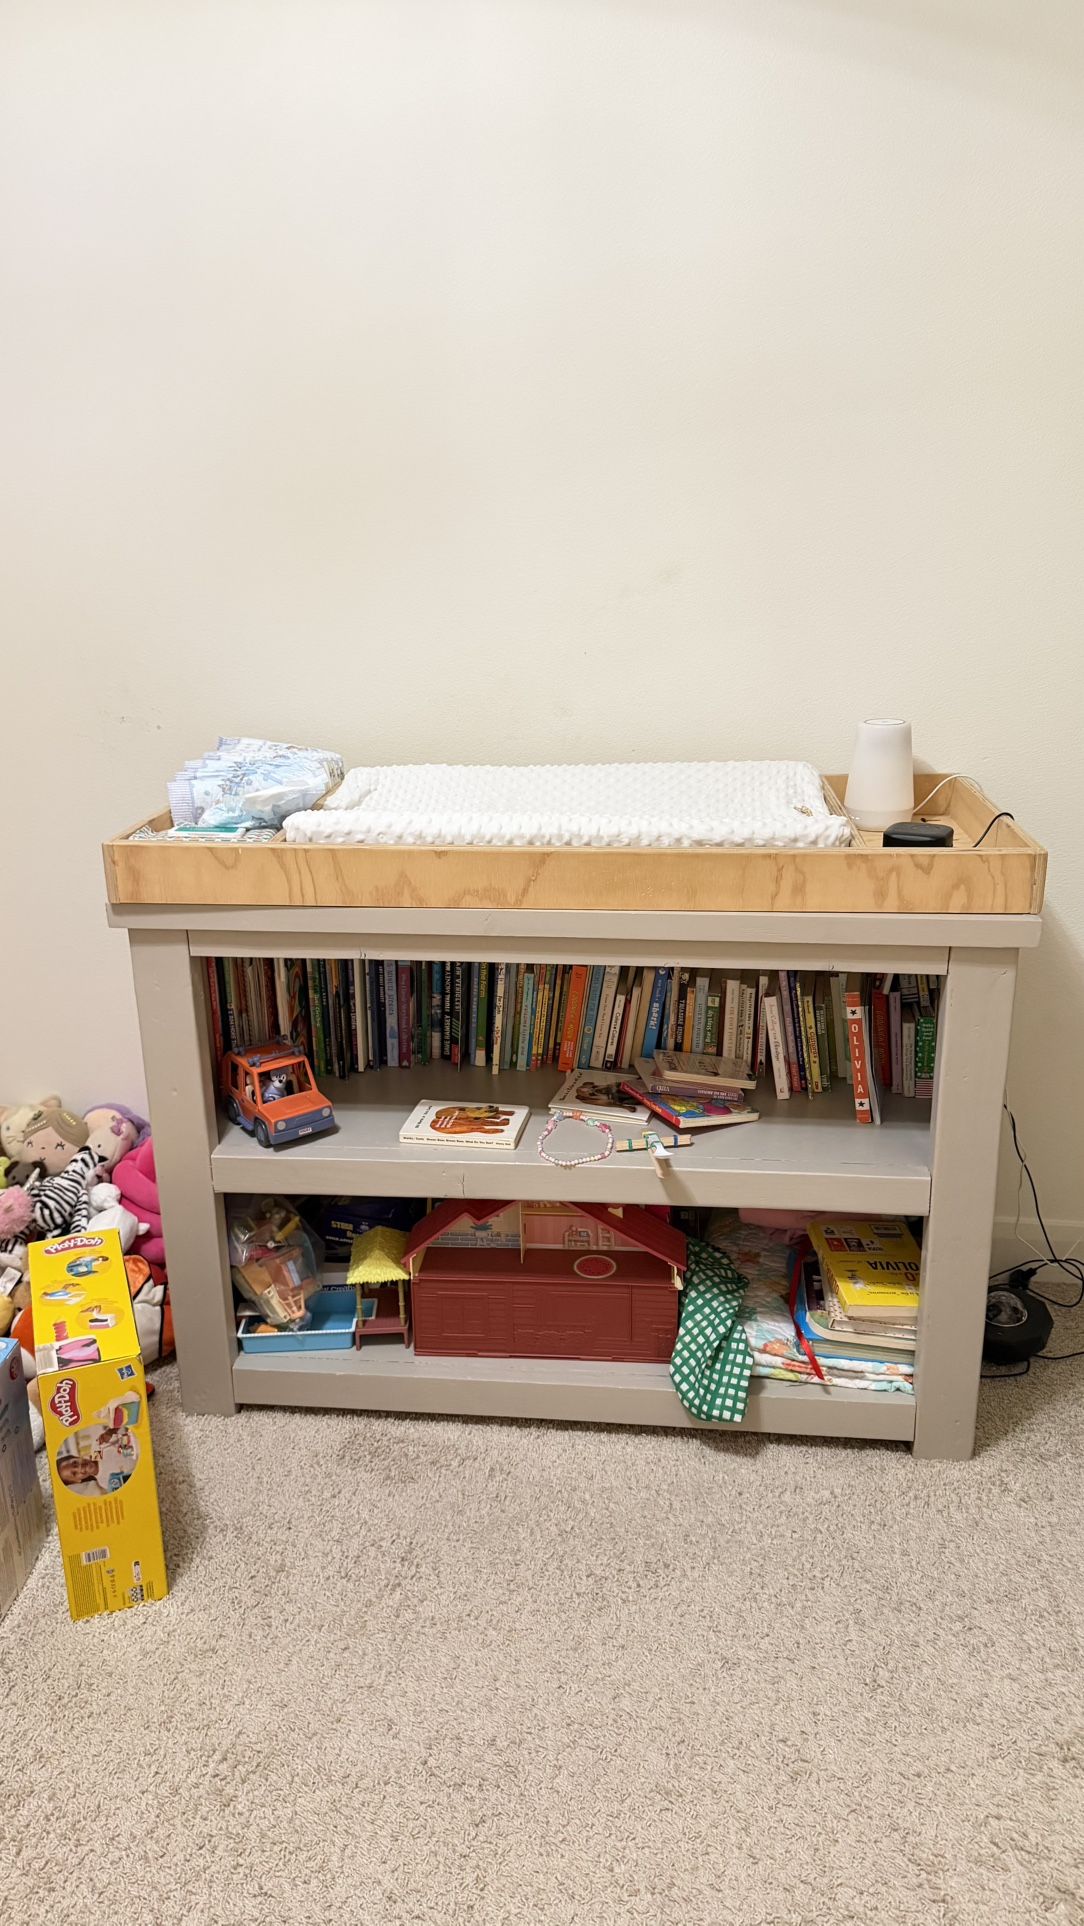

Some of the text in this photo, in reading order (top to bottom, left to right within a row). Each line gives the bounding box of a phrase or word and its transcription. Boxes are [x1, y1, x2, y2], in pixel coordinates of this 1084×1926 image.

[480, 970, 488, 980] the
[613, 1011, 621, 1027] Colors
[677, 999, 685, 1025] TREASURE
[851, 1024, 864, 1094] OLIVIA
[45, 1236, 102, 1253] Play-Doh
[865, 1261, 919, 1272] OLIVIA
[54, 1379, 78, 1426] Play-Doh
